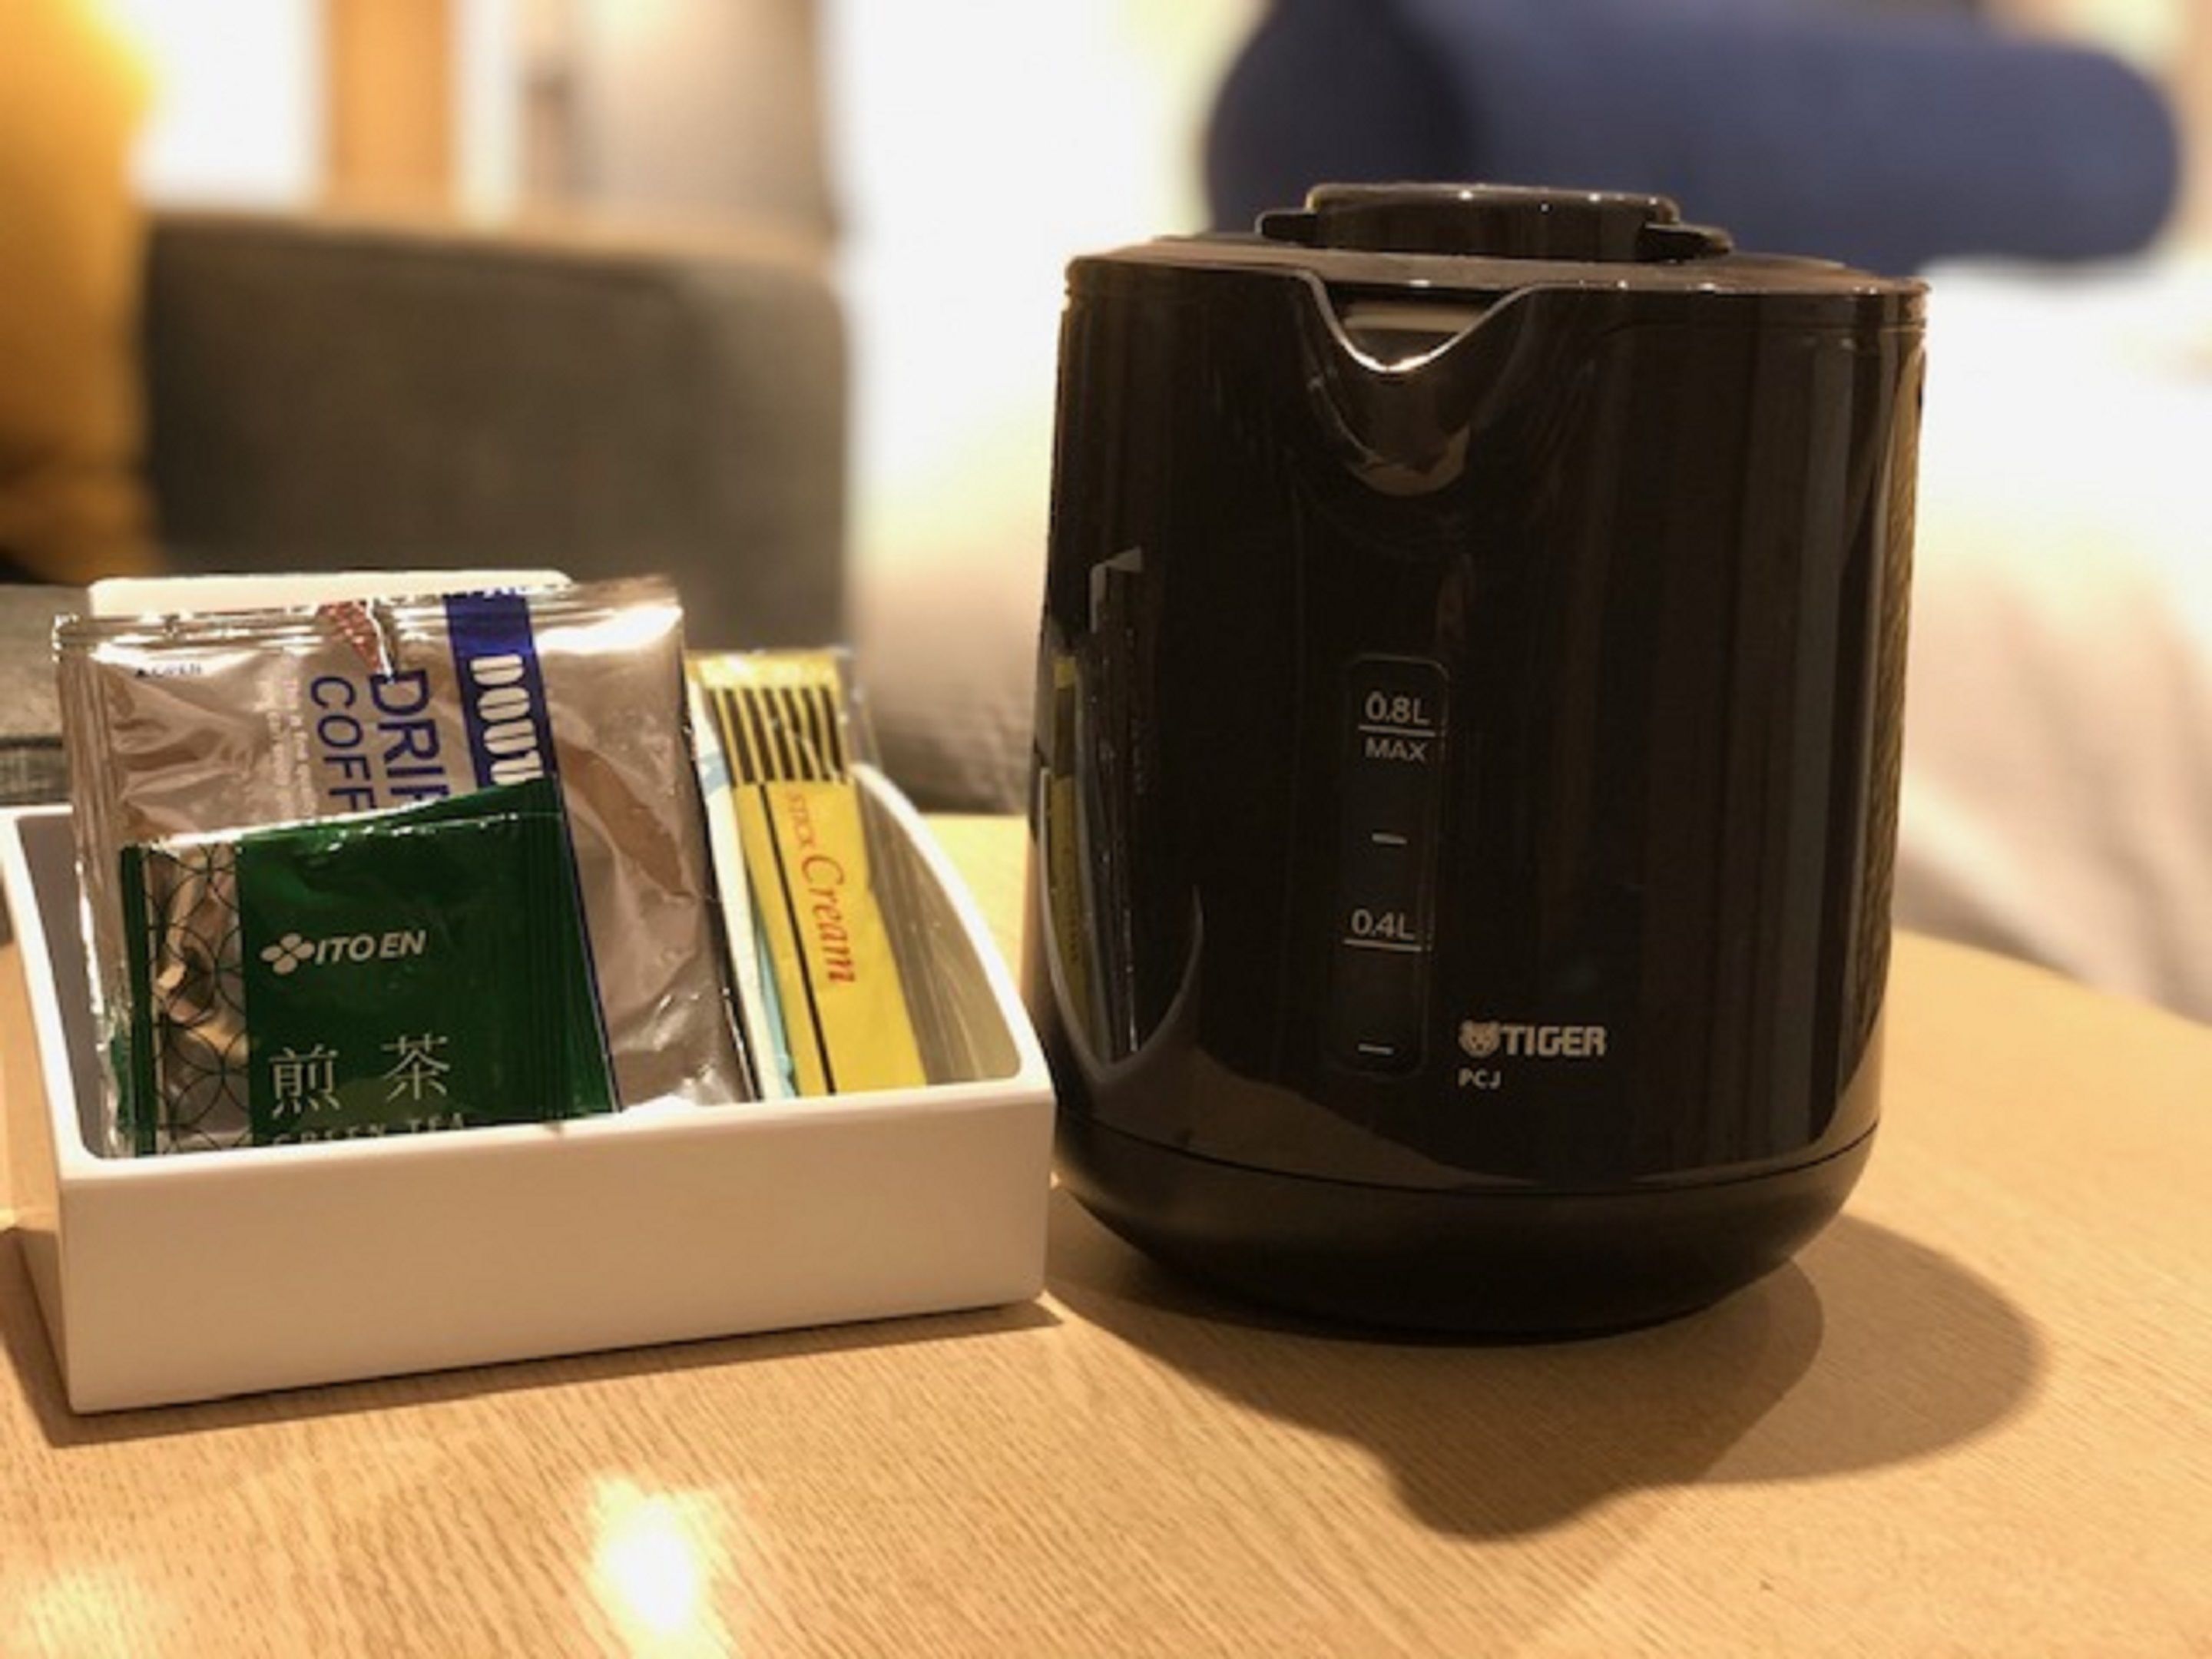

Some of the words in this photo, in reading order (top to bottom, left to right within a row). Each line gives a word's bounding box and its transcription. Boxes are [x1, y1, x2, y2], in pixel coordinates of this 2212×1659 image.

[1364, 690, 1432, 727] 0.8L
[1364, 736, 1427, 763] MAX
[801, 854, 856, 982] Cream
[1500, 1025, 1608, 1058] TIGER
[268, 1034, 451, 1119] 煎茶
[1458, 1068, 1503, 1090] PCJ
